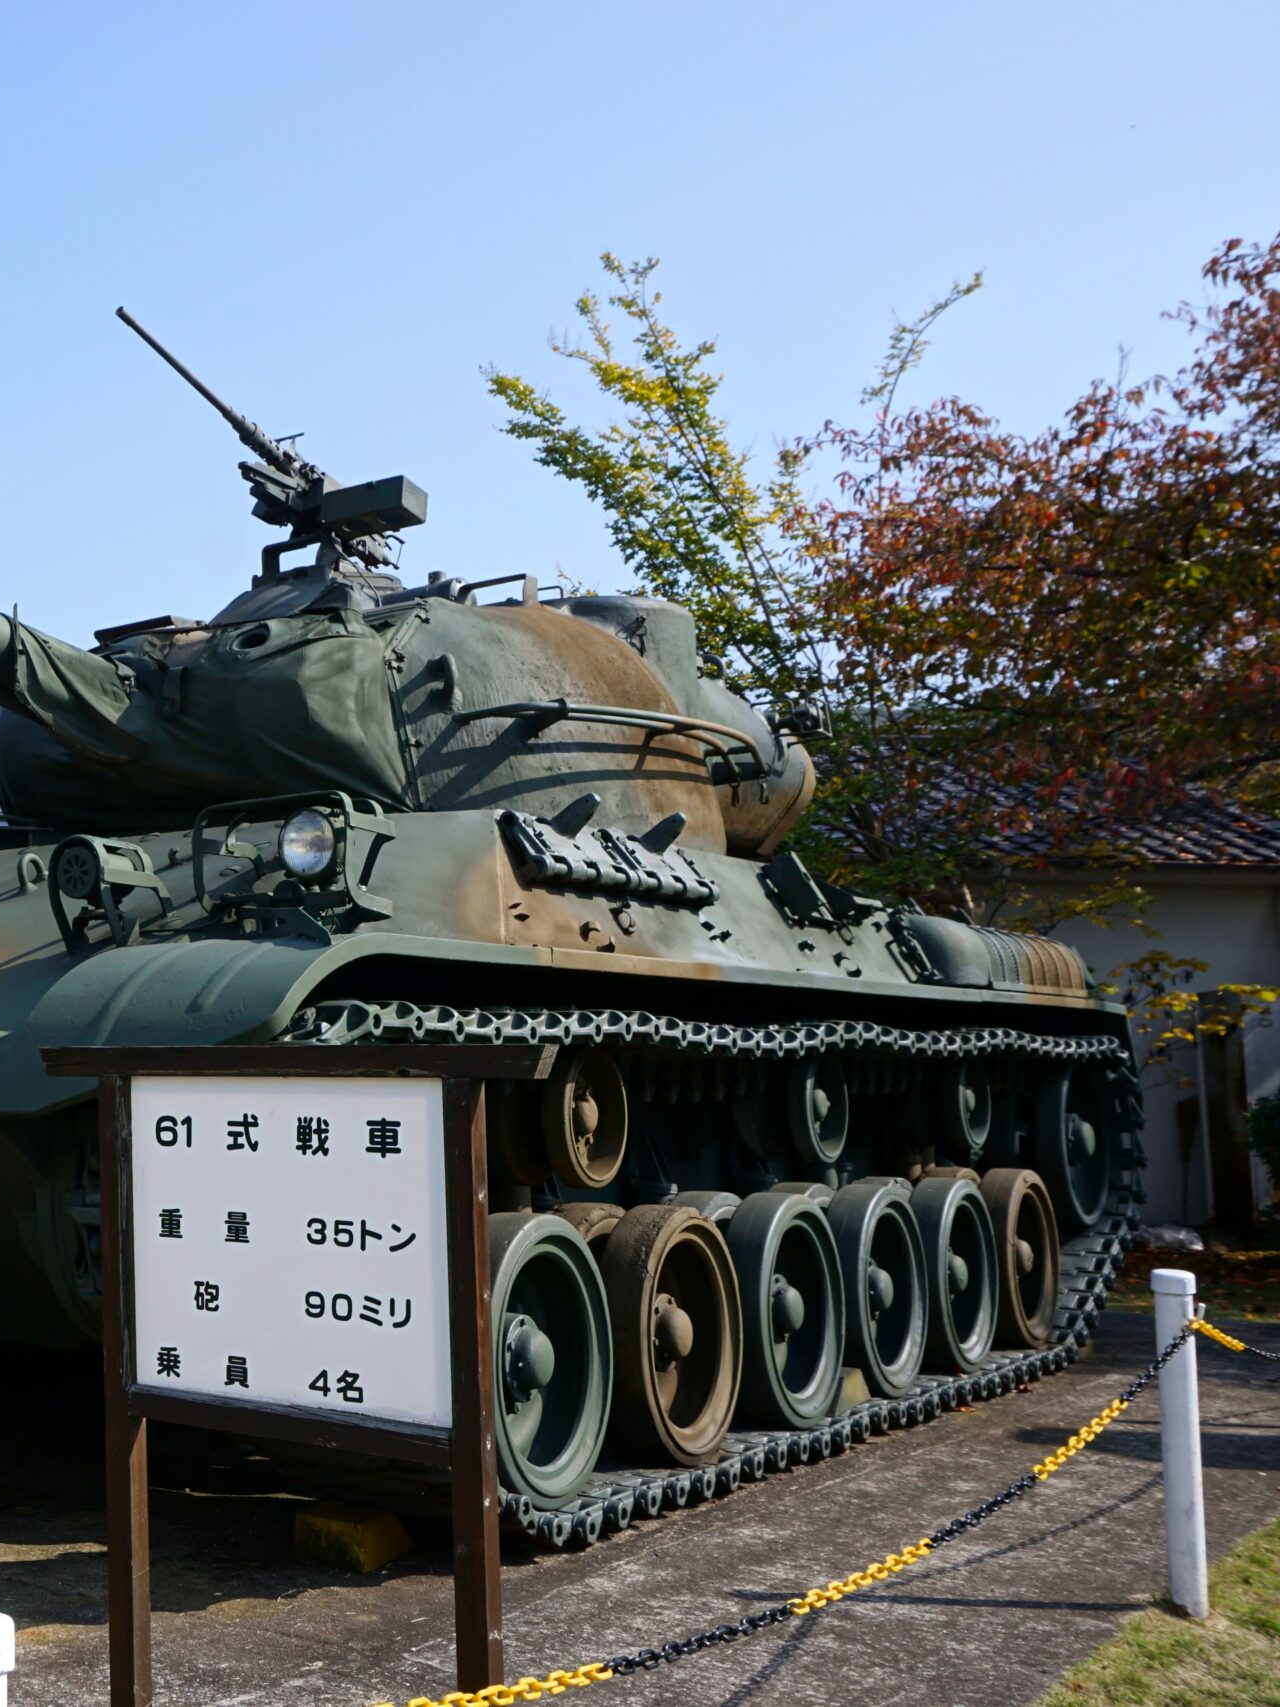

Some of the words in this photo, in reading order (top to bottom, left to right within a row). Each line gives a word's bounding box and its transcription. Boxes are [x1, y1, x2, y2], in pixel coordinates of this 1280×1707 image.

[155, 1112, 402, 1159] 61式戦車
[158, 1208, 251, 1244] 重量
[306, 1217, 417, 1253] 35トン
[193, 1280, 220, 1313] 砲
[304, 1290, 412, 1329] 90ミリ
[156, 1346, 250, 1389] 乗員
[308, 1369, 364, 1404] 4名
